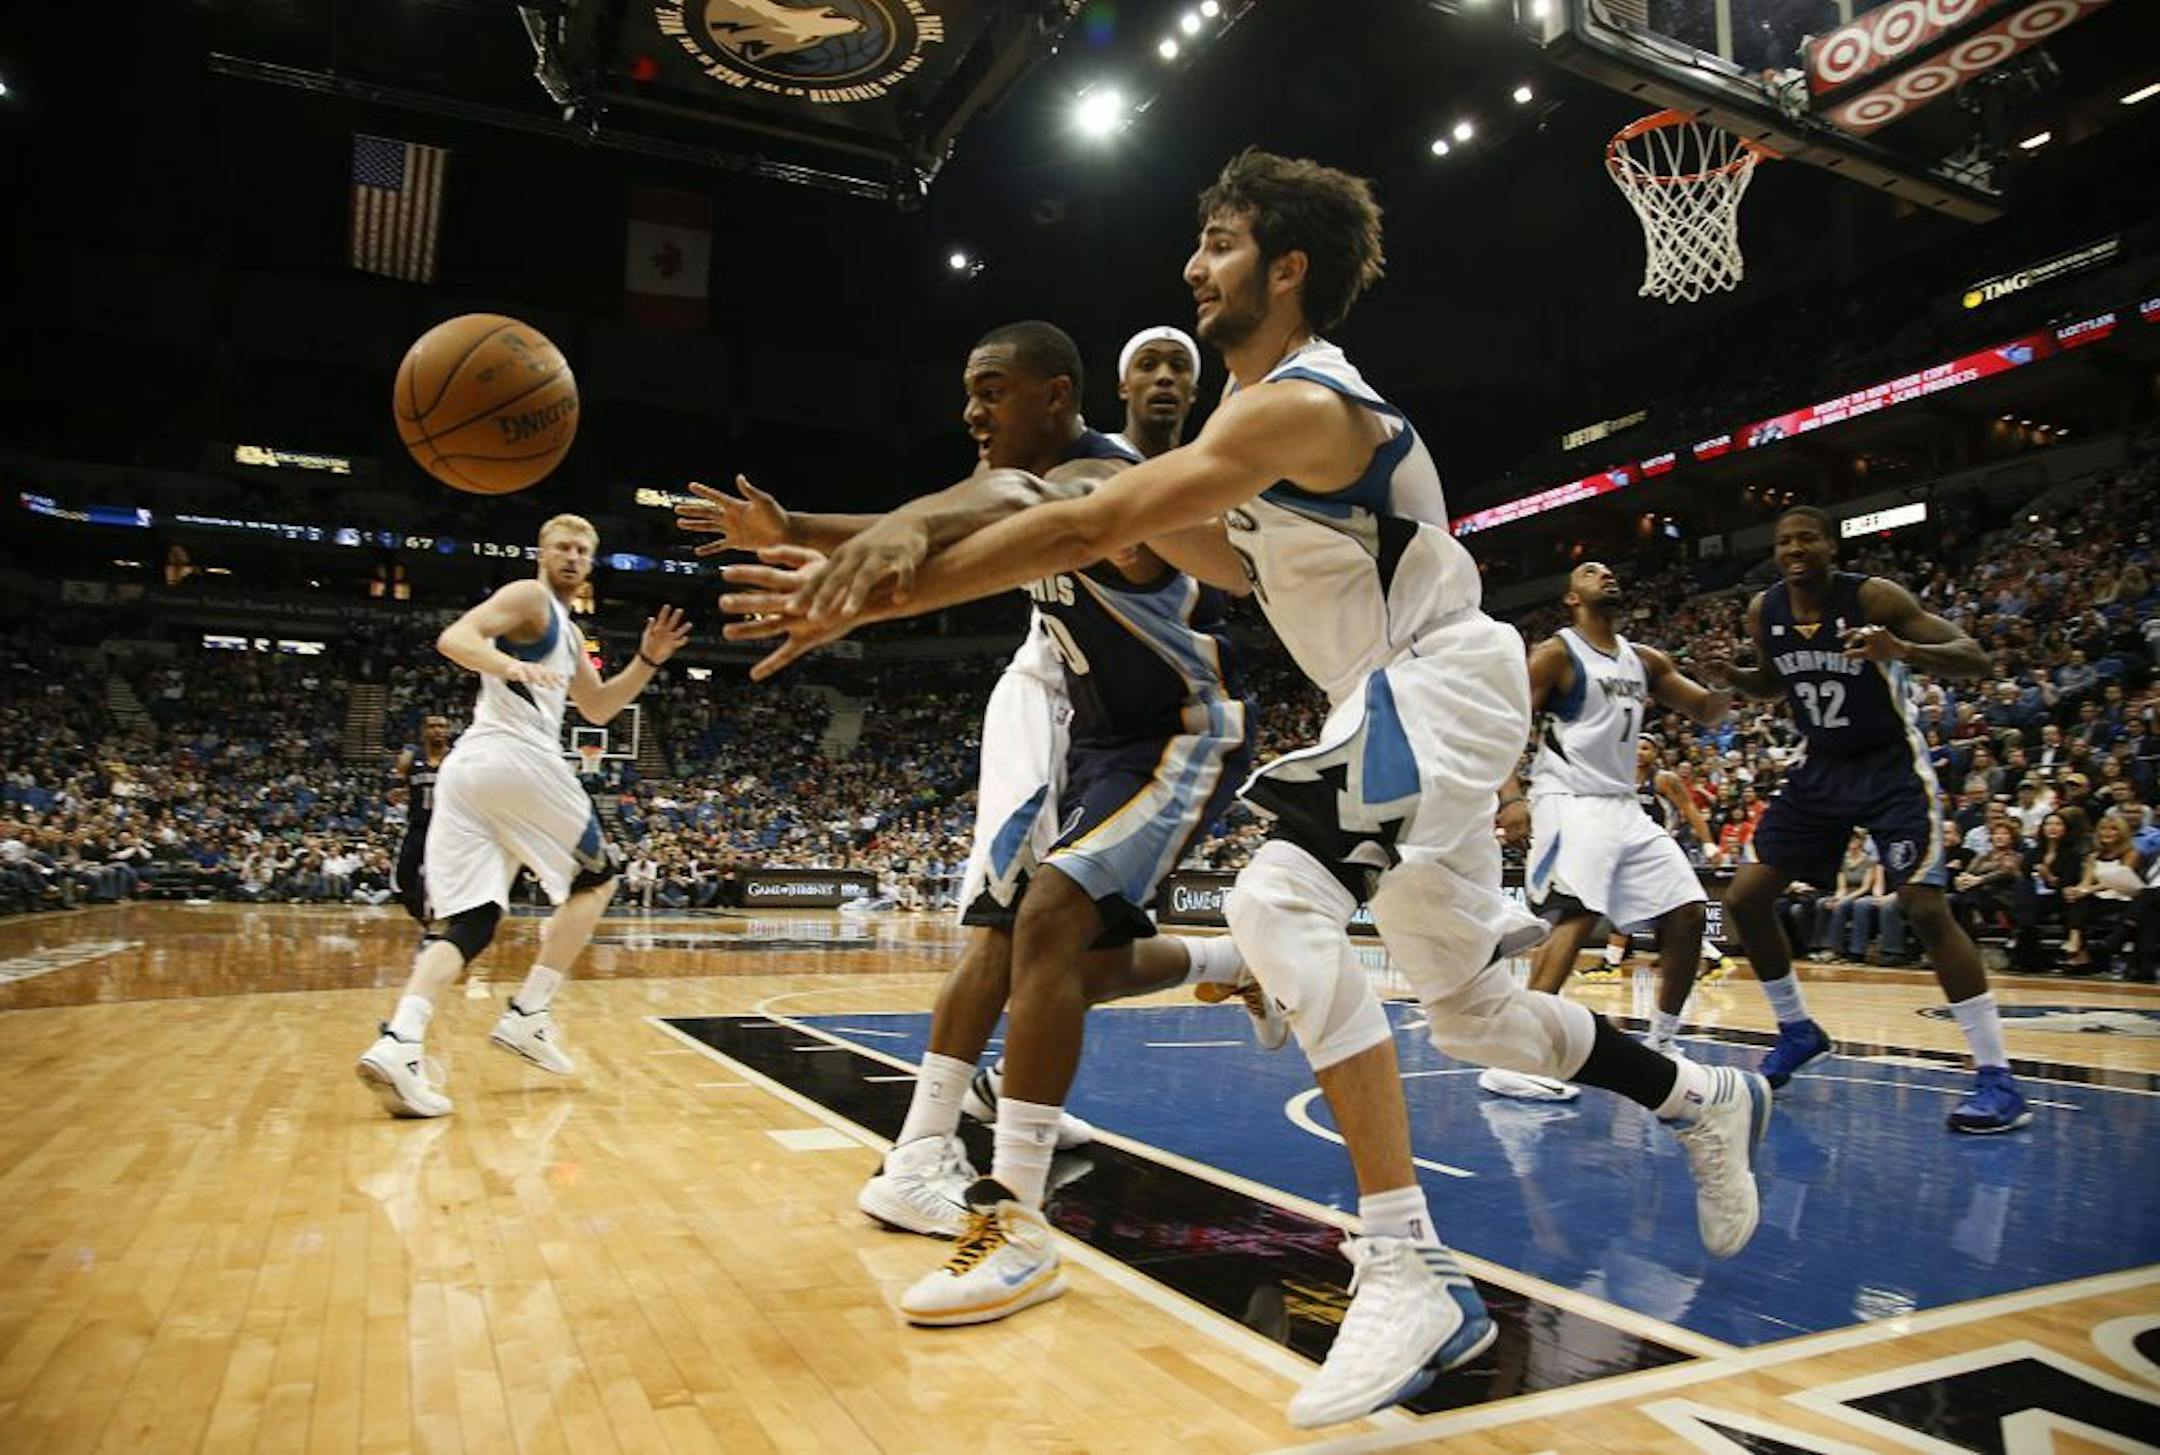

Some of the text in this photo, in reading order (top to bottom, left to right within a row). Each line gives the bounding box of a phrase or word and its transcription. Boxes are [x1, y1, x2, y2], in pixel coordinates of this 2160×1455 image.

[406, 536, 433, 550] 67
[473, 543, 520, 558] 13.9
[1773, 650, 1863, 676] MEMPHIS
[1794, 680, 1850, 729] 32
[1619, 707, 1633, 742] 1
[1173, 886, 1212, 912] GAME
